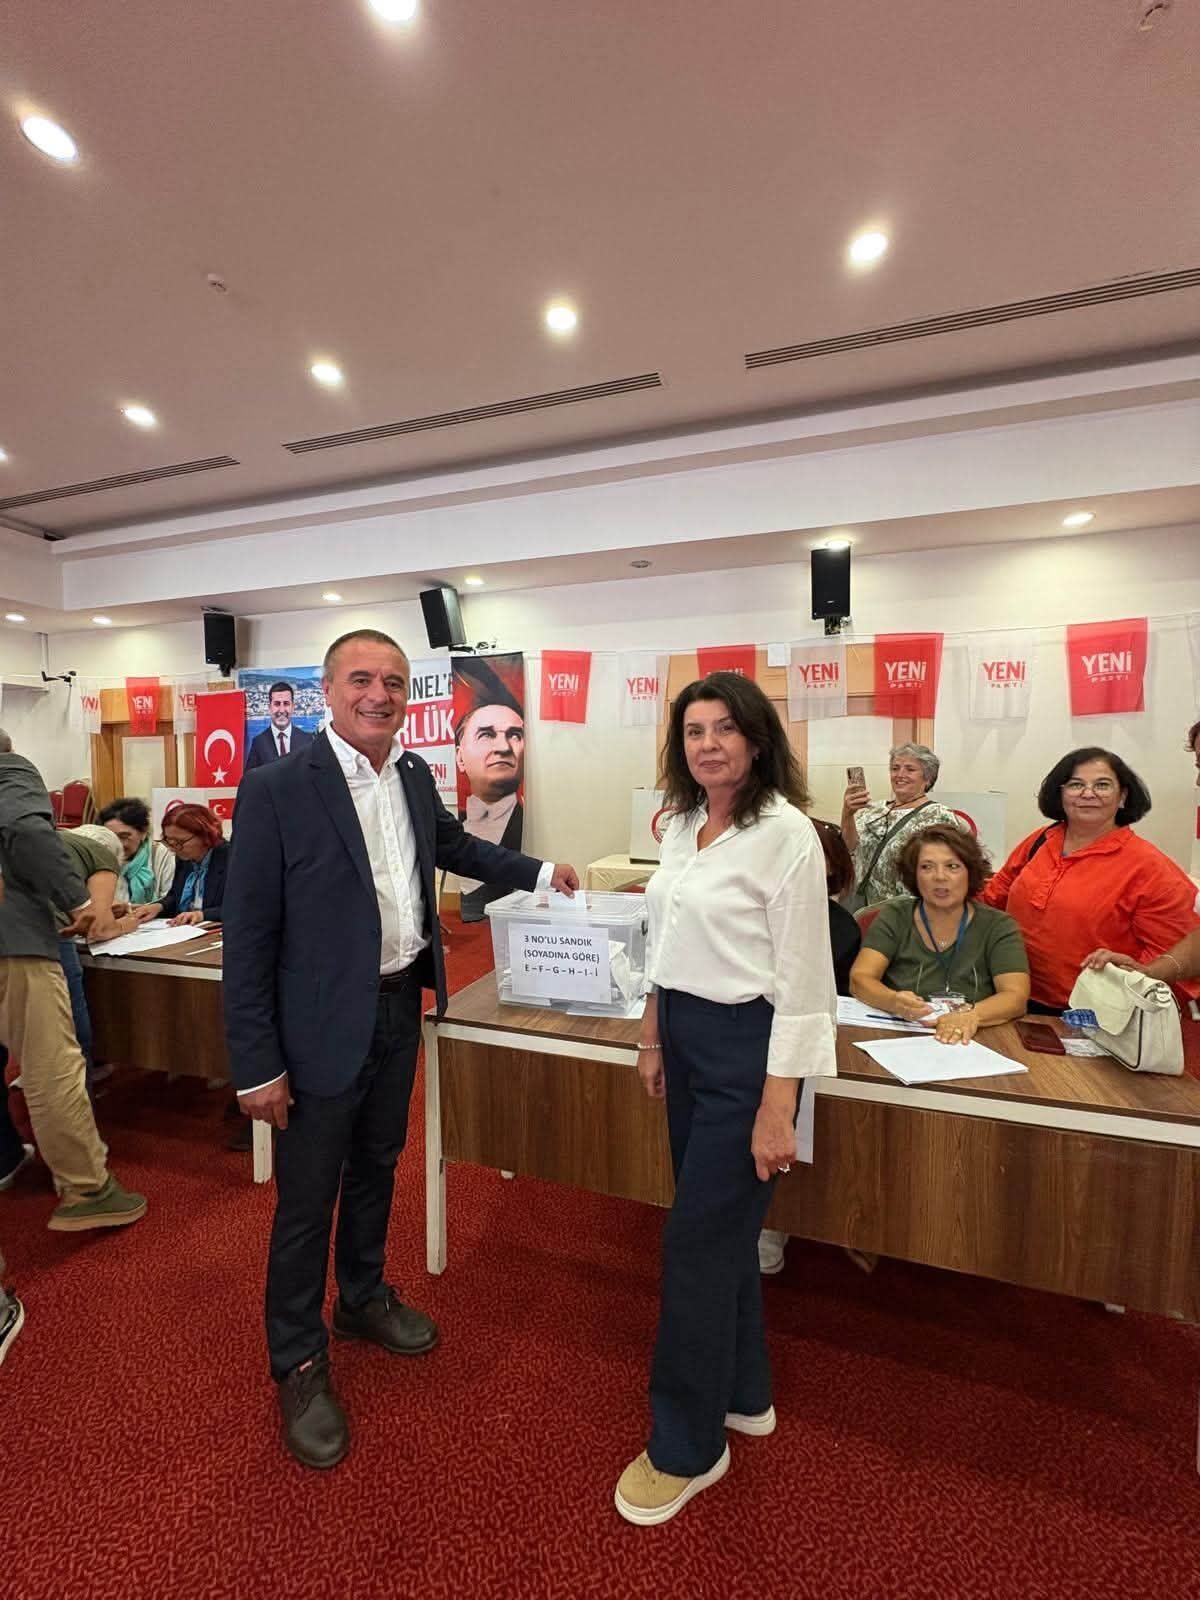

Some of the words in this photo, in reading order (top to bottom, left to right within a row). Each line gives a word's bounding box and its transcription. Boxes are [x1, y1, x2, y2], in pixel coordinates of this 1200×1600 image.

[524, 935, 529, 943] 3
[531, 935, 557, 945] NO'LU
[559, 937, 592, 947] SANDIK
[524, 949, 571, 960] (SOYADINA
[572, 952, 600, 964] GÖRE)
[552, 966, 560, 974] G
[568, 967, 575, 976] H
